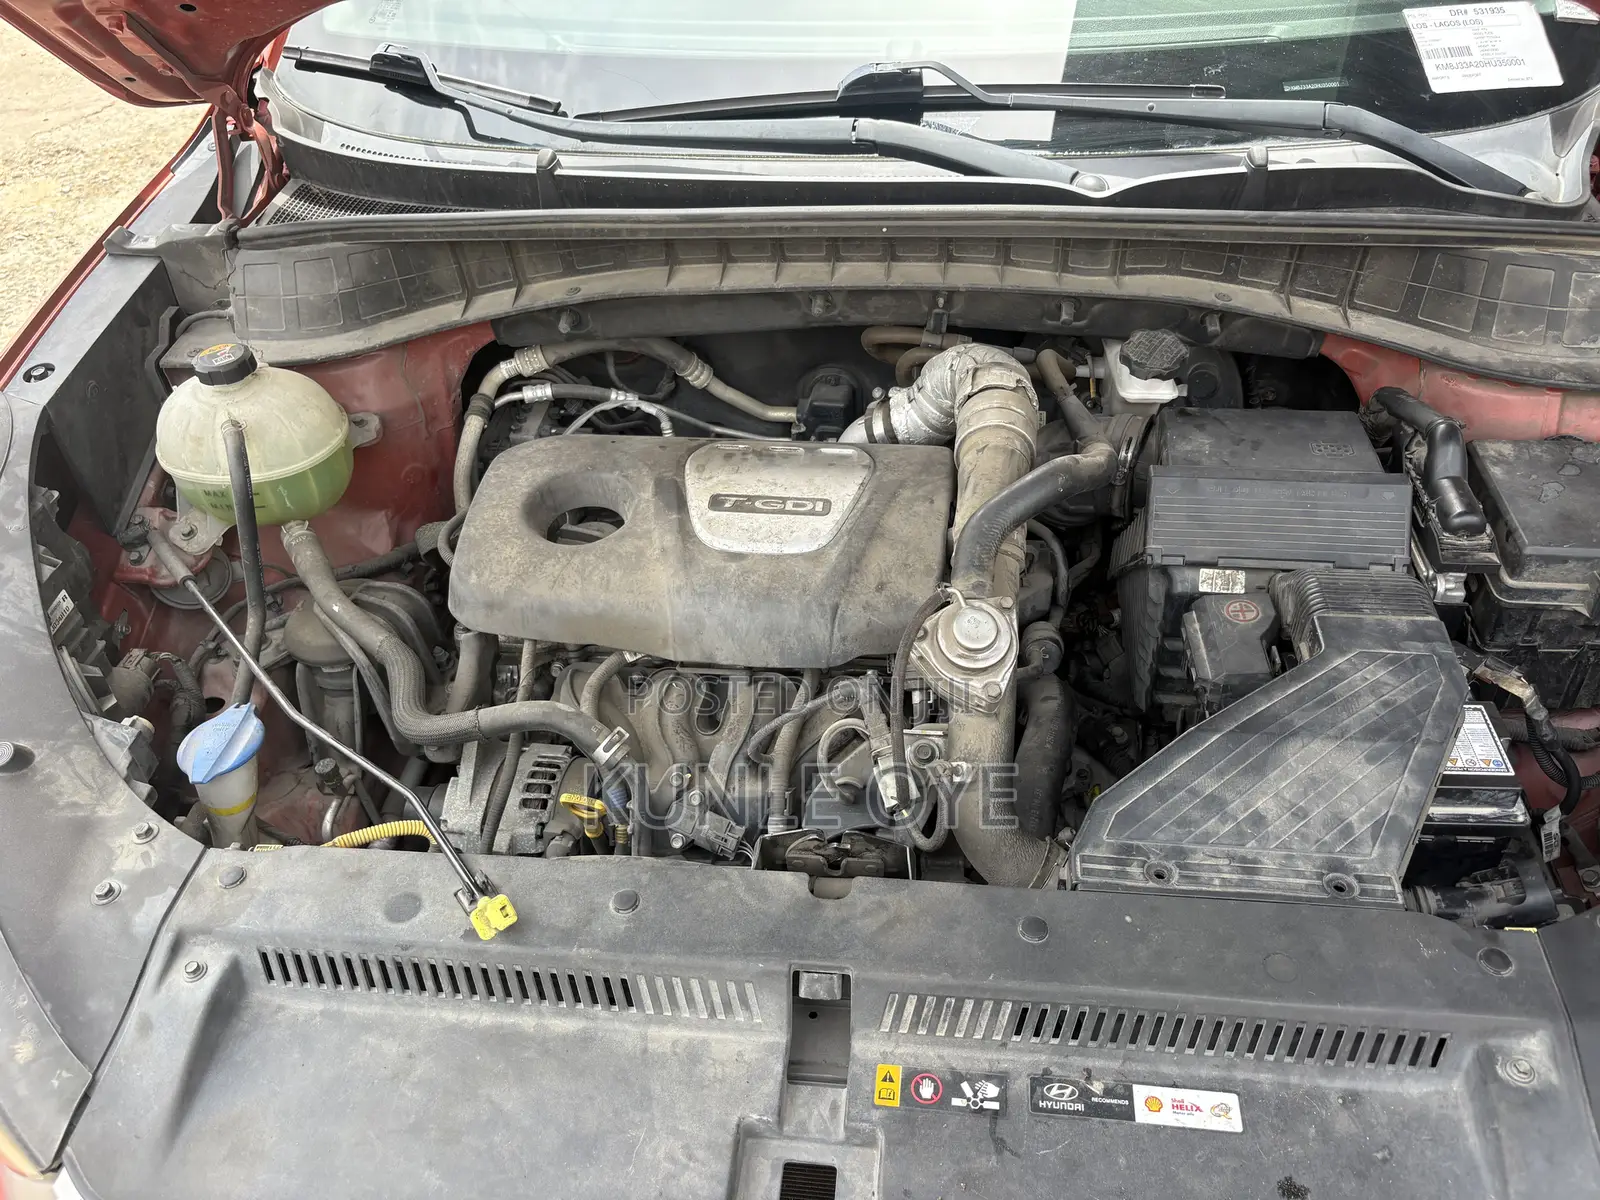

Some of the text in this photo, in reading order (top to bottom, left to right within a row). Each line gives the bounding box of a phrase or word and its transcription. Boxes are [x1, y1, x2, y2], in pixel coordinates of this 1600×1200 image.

[1473, 6, 1506, 16] 531935
[1411, 22, 1428, 30] LOS
[1433, 20, 1461, 28] LAGOS
[1462, 19, 1484, 27] (LOS)
[203, 489, 226, 498] MAX
[716, 496, 824, 512] T-GDI
[1039, 1097, 1130, 1112] HYUNDAI RECOMMENDS
[1171, 1102, 1204, 1113] HELIX
